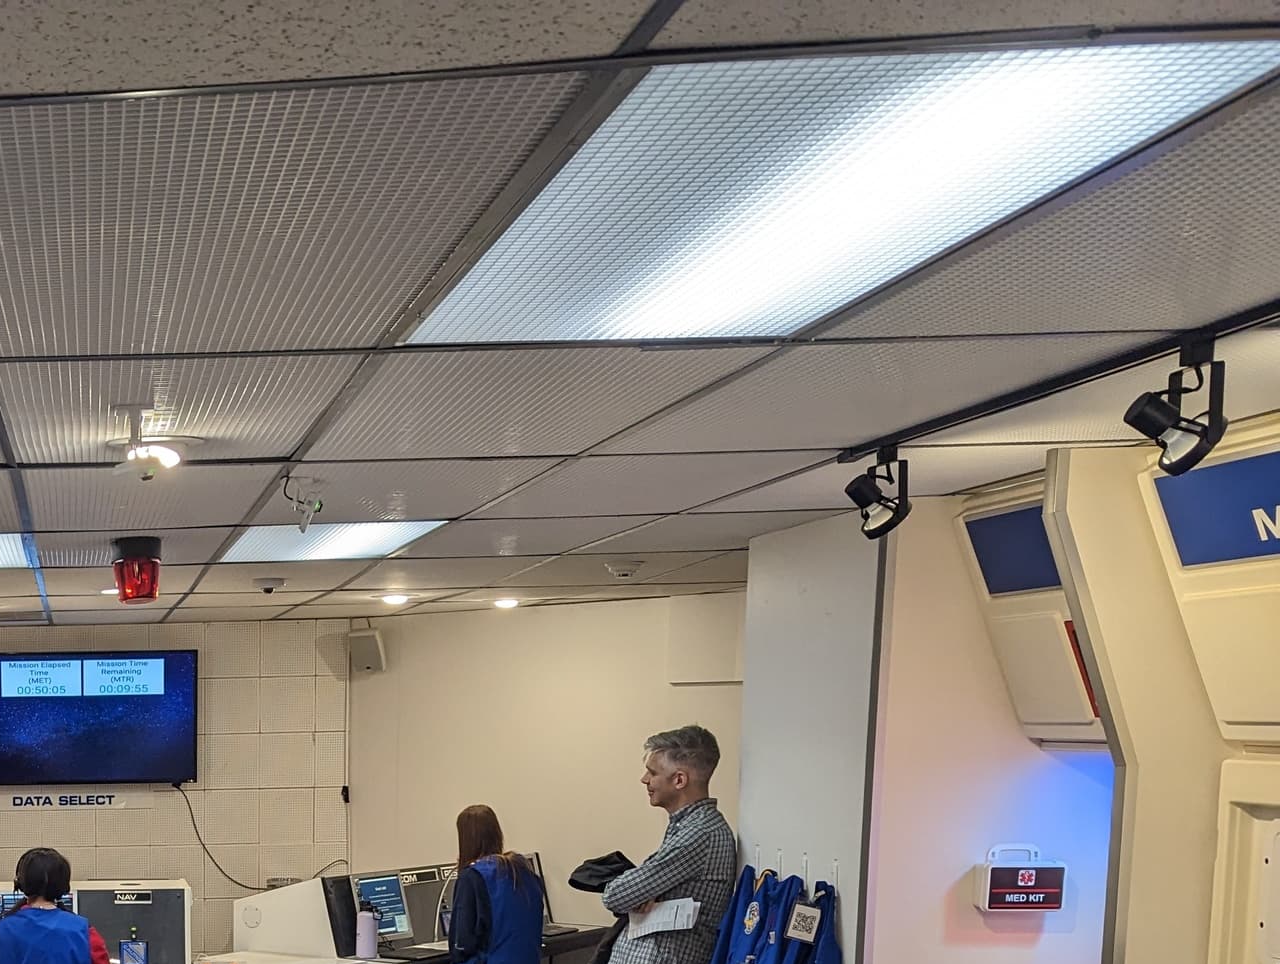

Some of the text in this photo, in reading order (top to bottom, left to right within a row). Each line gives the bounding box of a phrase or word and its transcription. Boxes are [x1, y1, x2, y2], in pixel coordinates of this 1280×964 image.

[41, 661, 70, 670] Elapsed
[28, 677, 52, 685] (MET)
[110, 676, 134, 684] (MTR)
[17, 686, 66, 695] 00:50:05
[99, 685, 149, 694] 00:09:55
[12, 795, 116, 807] DATA SELECT
[116, 893, 137, 901] NAV
[1005, 894, 1045, 902] MED KIT
